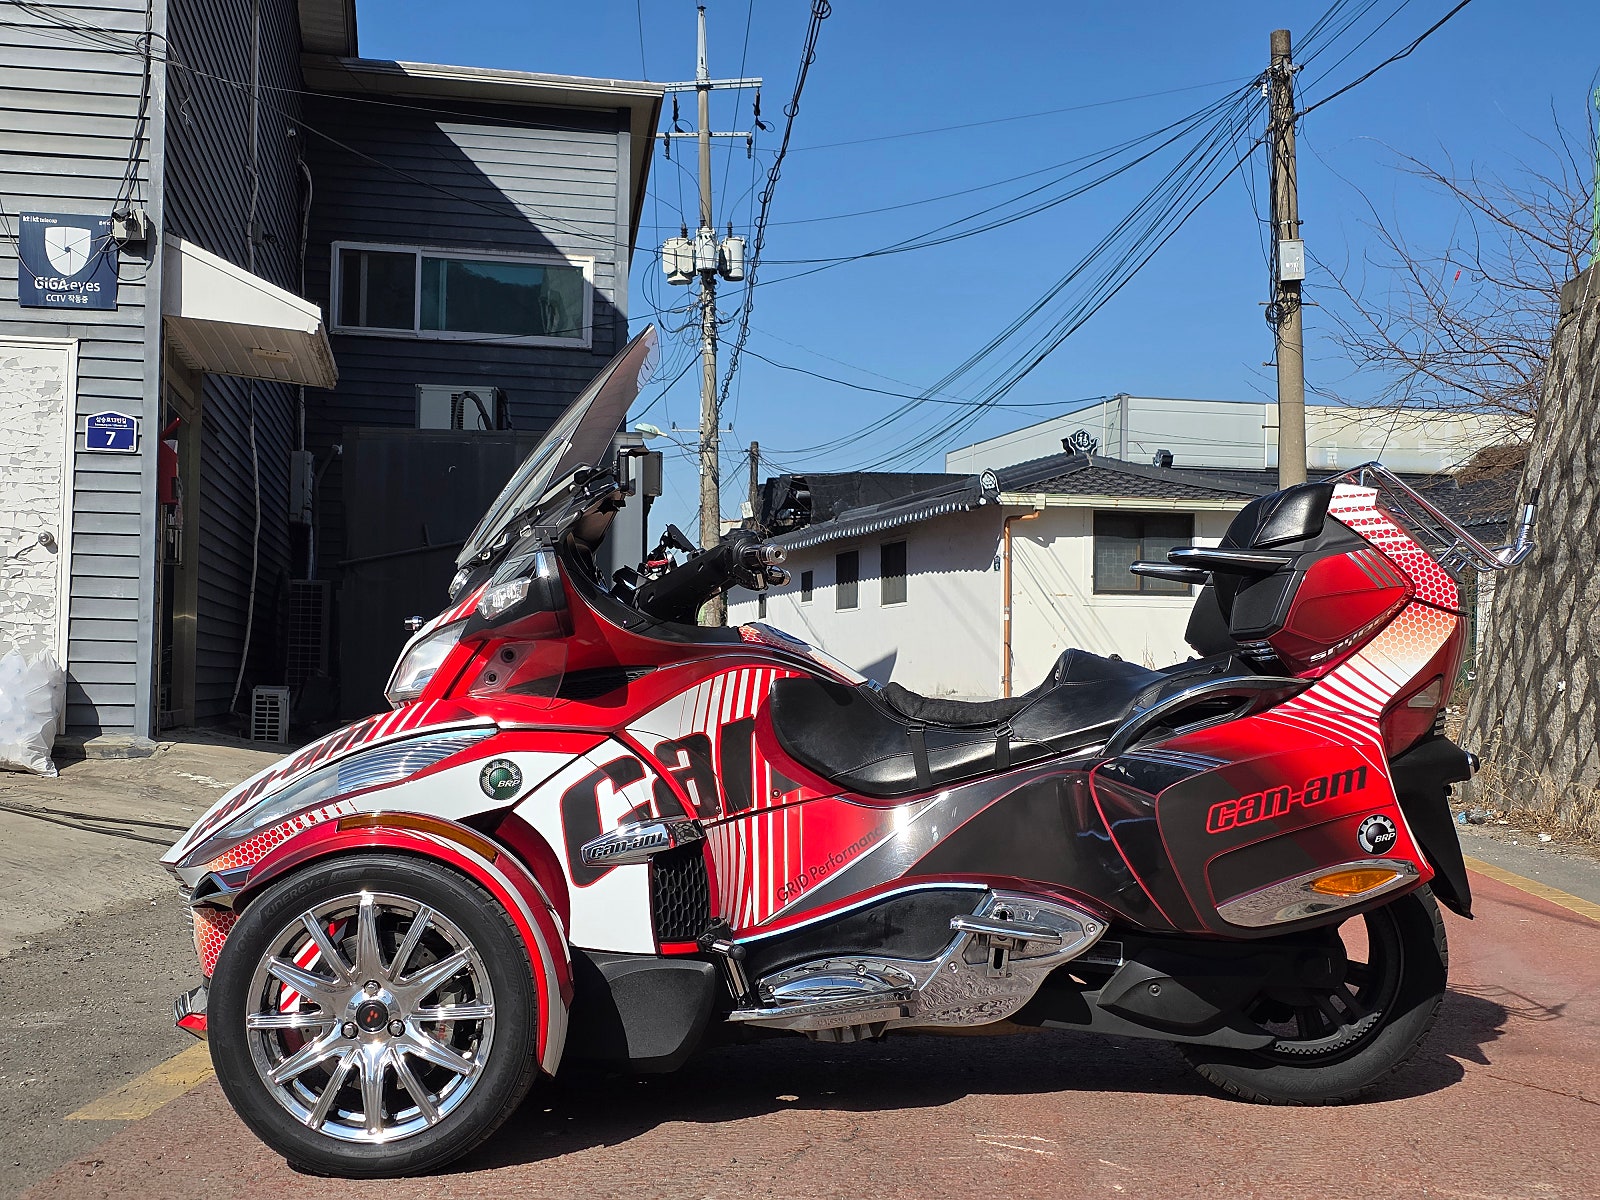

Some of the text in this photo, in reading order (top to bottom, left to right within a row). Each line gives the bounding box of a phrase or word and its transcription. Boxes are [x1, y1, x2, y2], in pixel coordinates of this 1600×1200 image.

[45, 294, 89, 304] CCTV 작동중
[105, 431, 116, 446] 7
[497, 779, 521, 788] BRP
[1205, 765, 1369, 835] can-am
[1374, 832, 1396, 843] BRP
[590, 832, 664, 860] can-am
[776, 874, 809, 902] GRID
